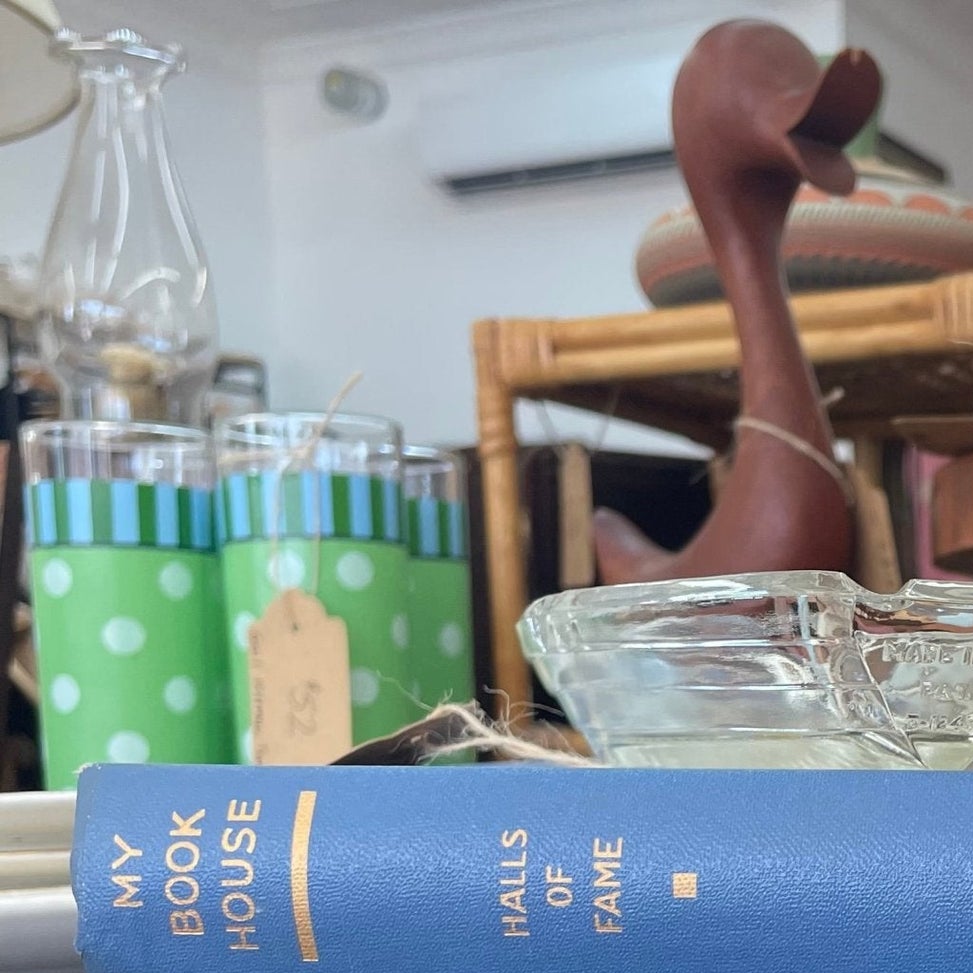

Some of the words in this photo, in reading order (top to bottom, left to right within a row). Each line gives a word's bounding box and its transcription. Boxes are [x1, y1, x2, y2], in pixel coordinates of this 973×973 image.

[112, 834, 144, 909] MY
[166, 809, 207, 936] BOOK
[222, 799, 262, 951] HOUSE
[503, 828, 530, 937] HALLS
[546, 868, 575, 908] OF
[594, 837, 624, 935] FAME
